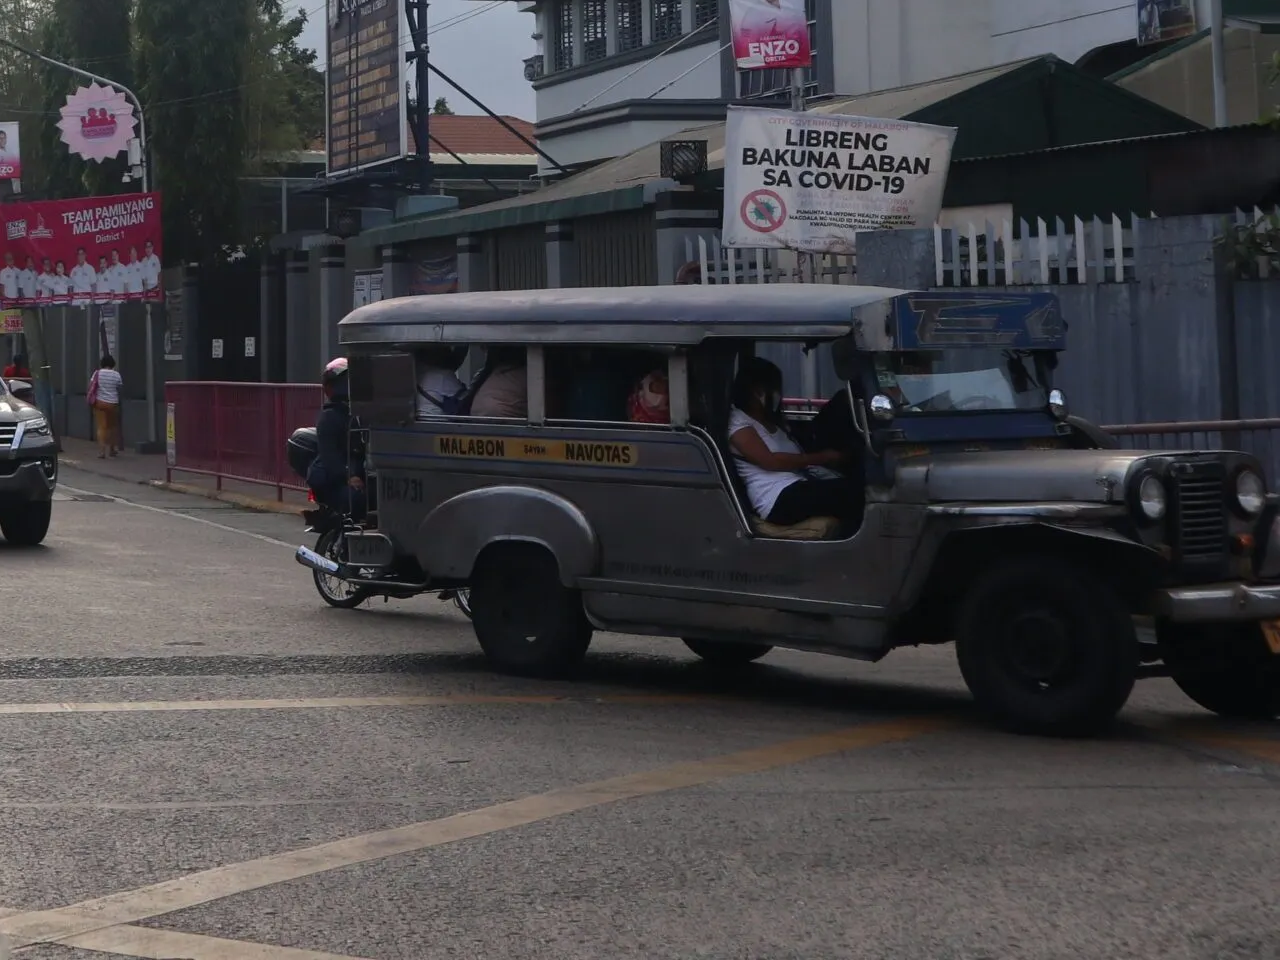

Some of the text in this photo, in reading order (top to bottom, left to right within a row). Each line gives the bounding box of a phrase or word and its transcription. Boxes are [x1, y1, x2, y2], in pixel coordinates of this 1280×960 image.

[748, 39, 800, 57] ENZO
[785, 128, 888, 151] LIBRENG
[742, 147, 931, 176] BAKUNA LABAN
[763, 168, 905, 194] SA COVID-19
[61, 197, 154, 225] TEAM PAMILYANG
[72, 210, 145, 235] MALABONIAN
[95, 231, 120, 244] District
[439, 437, 505, 457] MALABON
[564, 442, 631, 464] NAVOTAS
